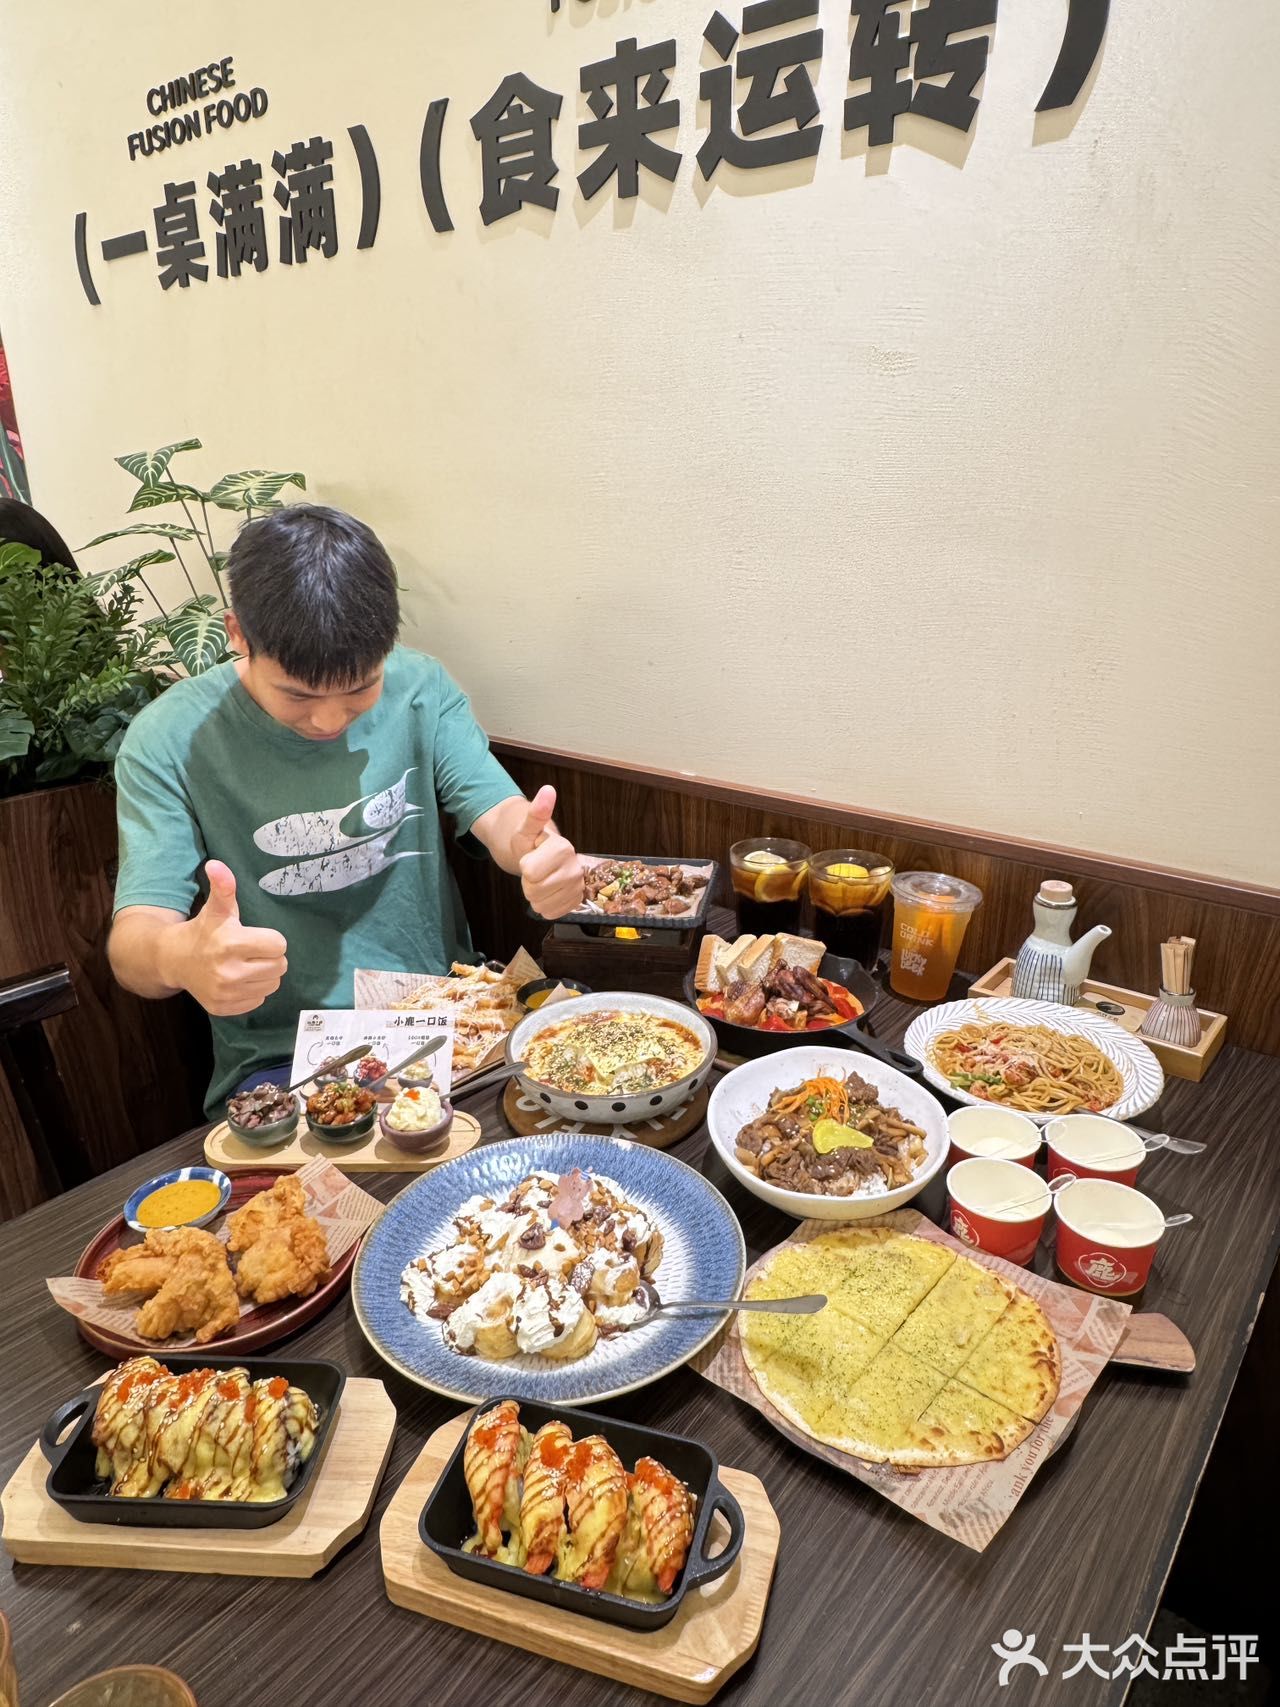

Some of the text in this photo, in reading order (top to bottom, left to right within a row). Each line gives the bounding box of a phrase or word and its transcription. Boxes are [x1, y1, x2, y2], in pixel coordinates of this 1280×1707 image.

[146, 56, 236, 117] CHINESE
[127, 87, 268, 161] FUSION FOOD
[394, 1016, 448, 1027] 小鹿一口饭
[1021, 1450, 1037, 1475] you
[1030, 1434, 1046, 1455] for
[1041, 1416, 1054, 1434] the
